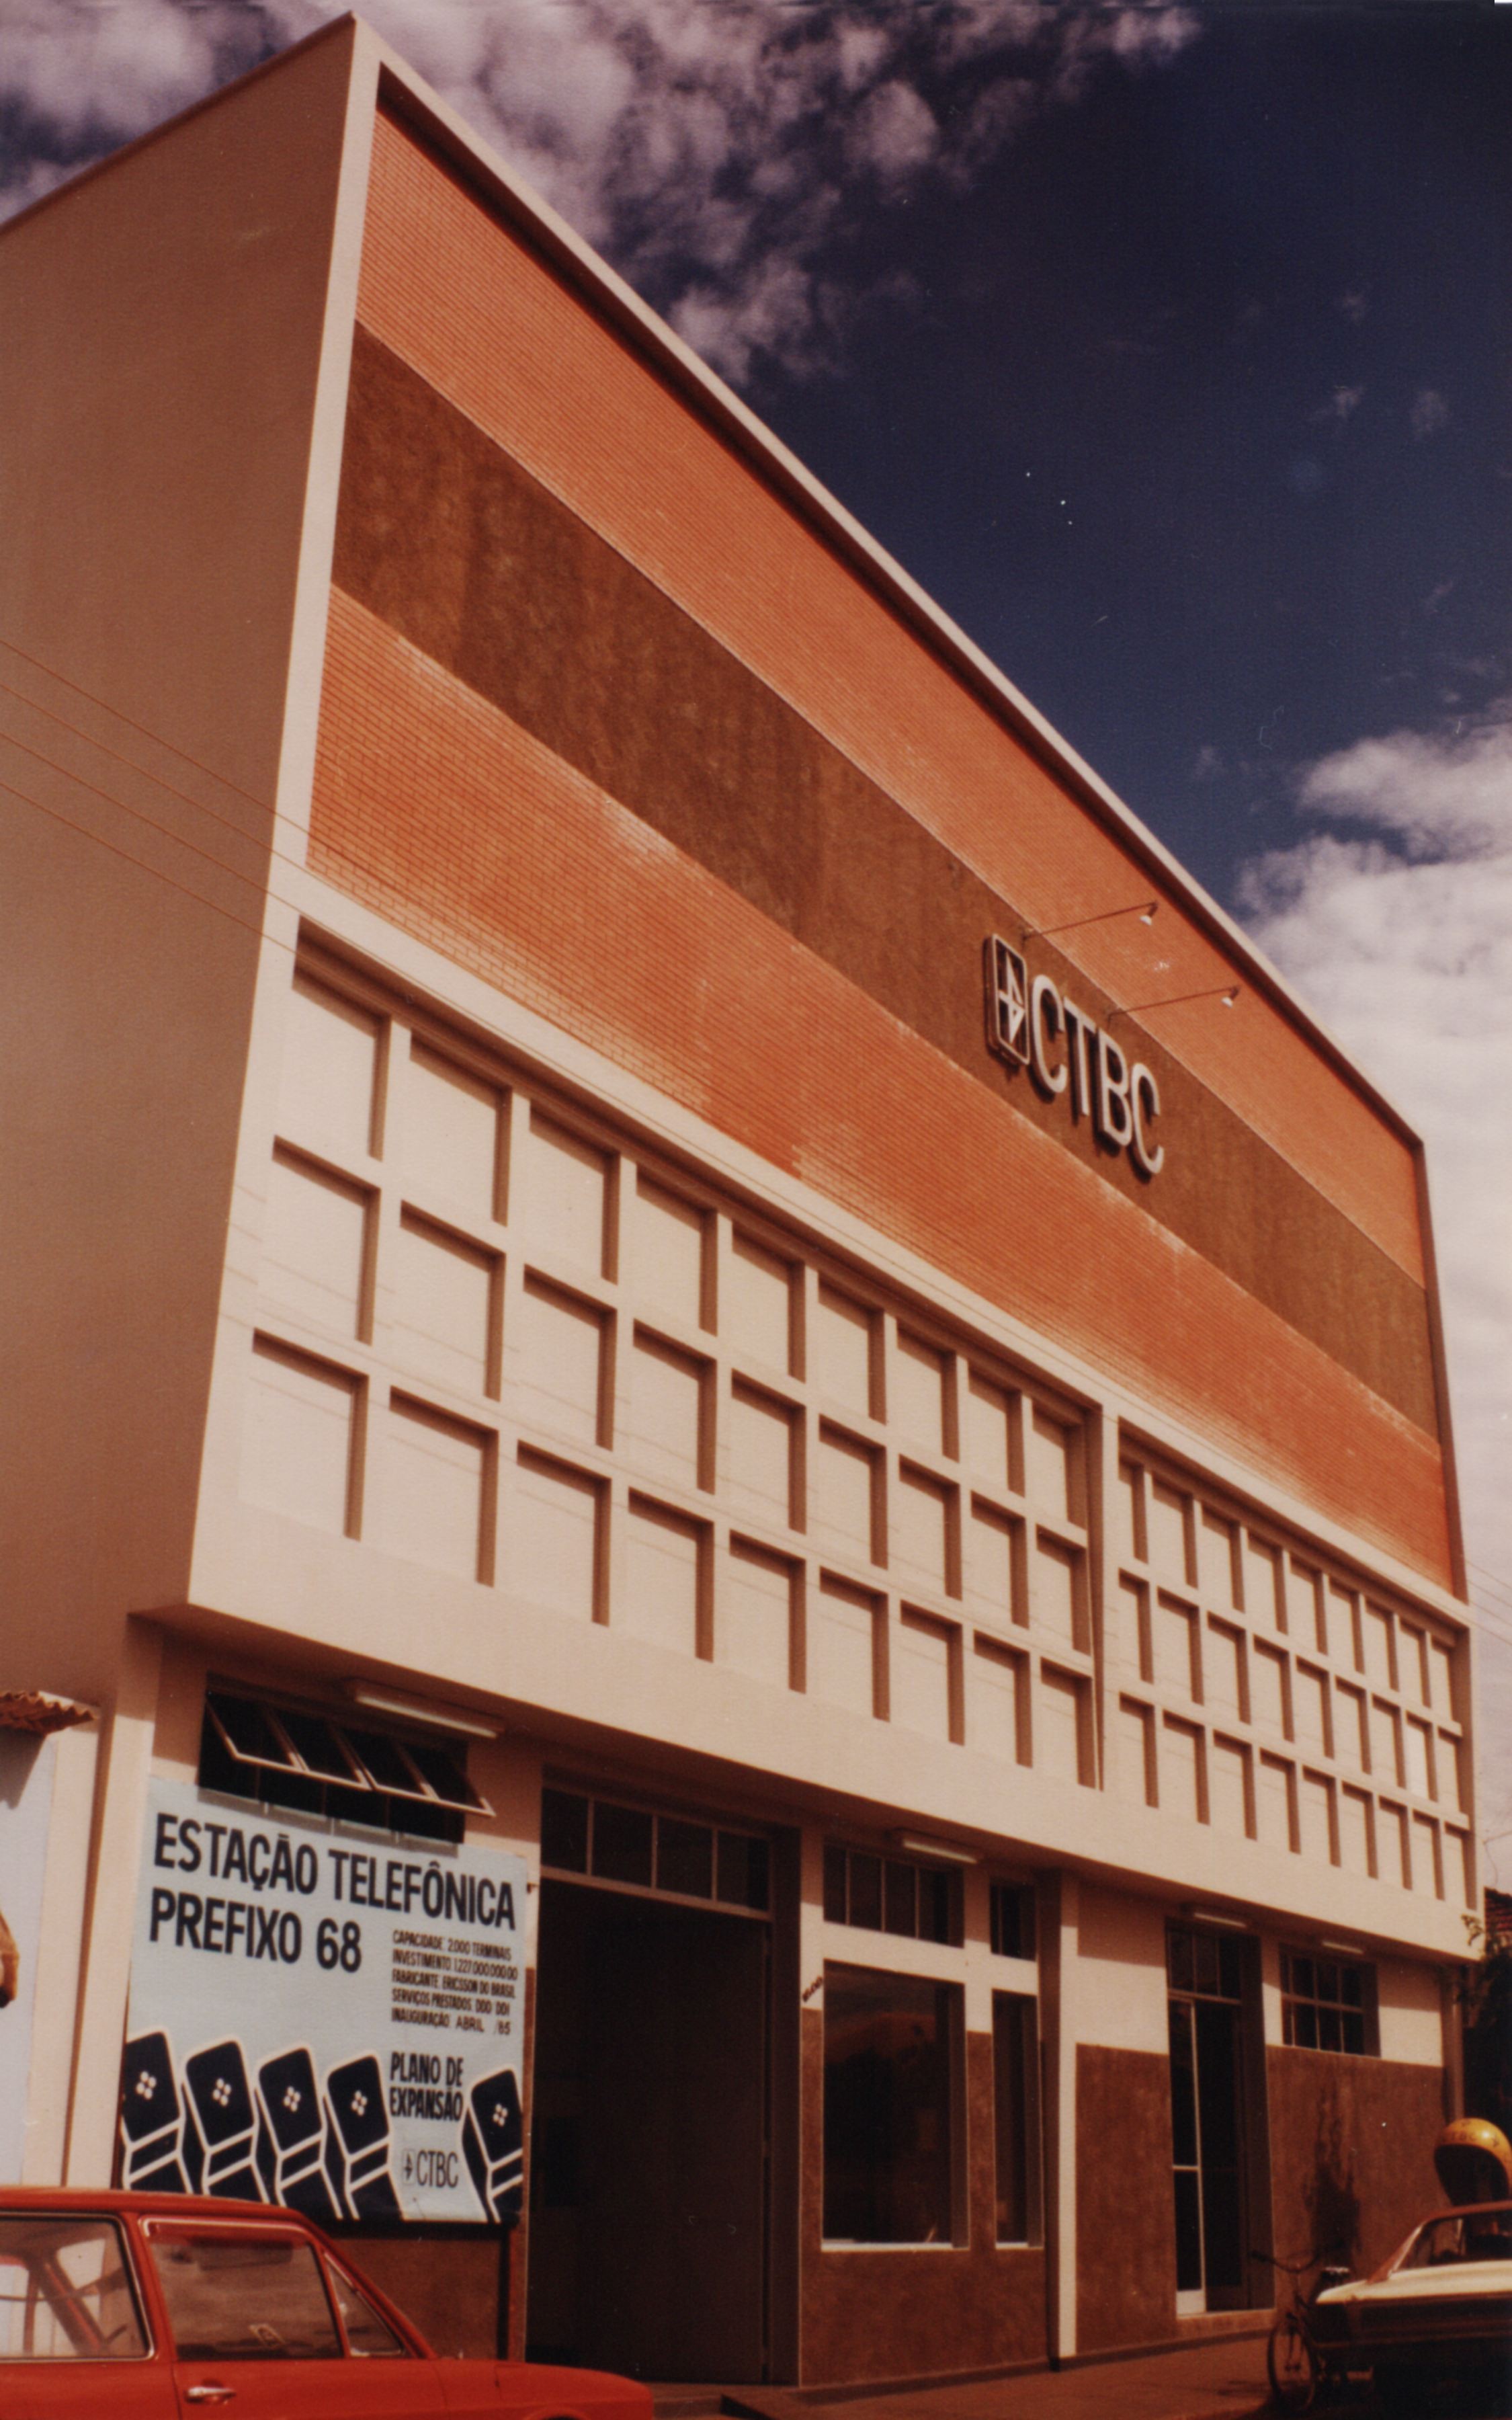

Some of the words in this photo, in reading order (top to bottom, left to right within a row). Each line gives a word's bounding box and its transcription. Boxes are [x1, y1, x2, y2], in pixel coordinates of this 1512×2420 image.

[1031, 974, 1165, 1174] CTBC
[154, 1812, 319, 1895] ESTAÇÃO
[327, 1848, 516, 1931] TELEFÔNICA
[149, 1886, 302, 1964] PREFIXO
[317, 1917, 362, 1973] 68
[473, 1941, 511, 1961] TERMINAIS
[392, 1988, 429, 2006] SERVIÇOS
[443, 1975, 477, 1993] ERICSSON
[480, 1979, 489, 1994] DO
[491, 1981, 515, 1999] BRASIL
[456, 2015, 485, 2033] ABRIL
[390, 2052, 441, 2085] PLANO
[446, 2056, 464, 2087] DE
[389, 2085, 464, 2122] EXPANSÃO
[417, 2150, 458, 2188] CTBC
